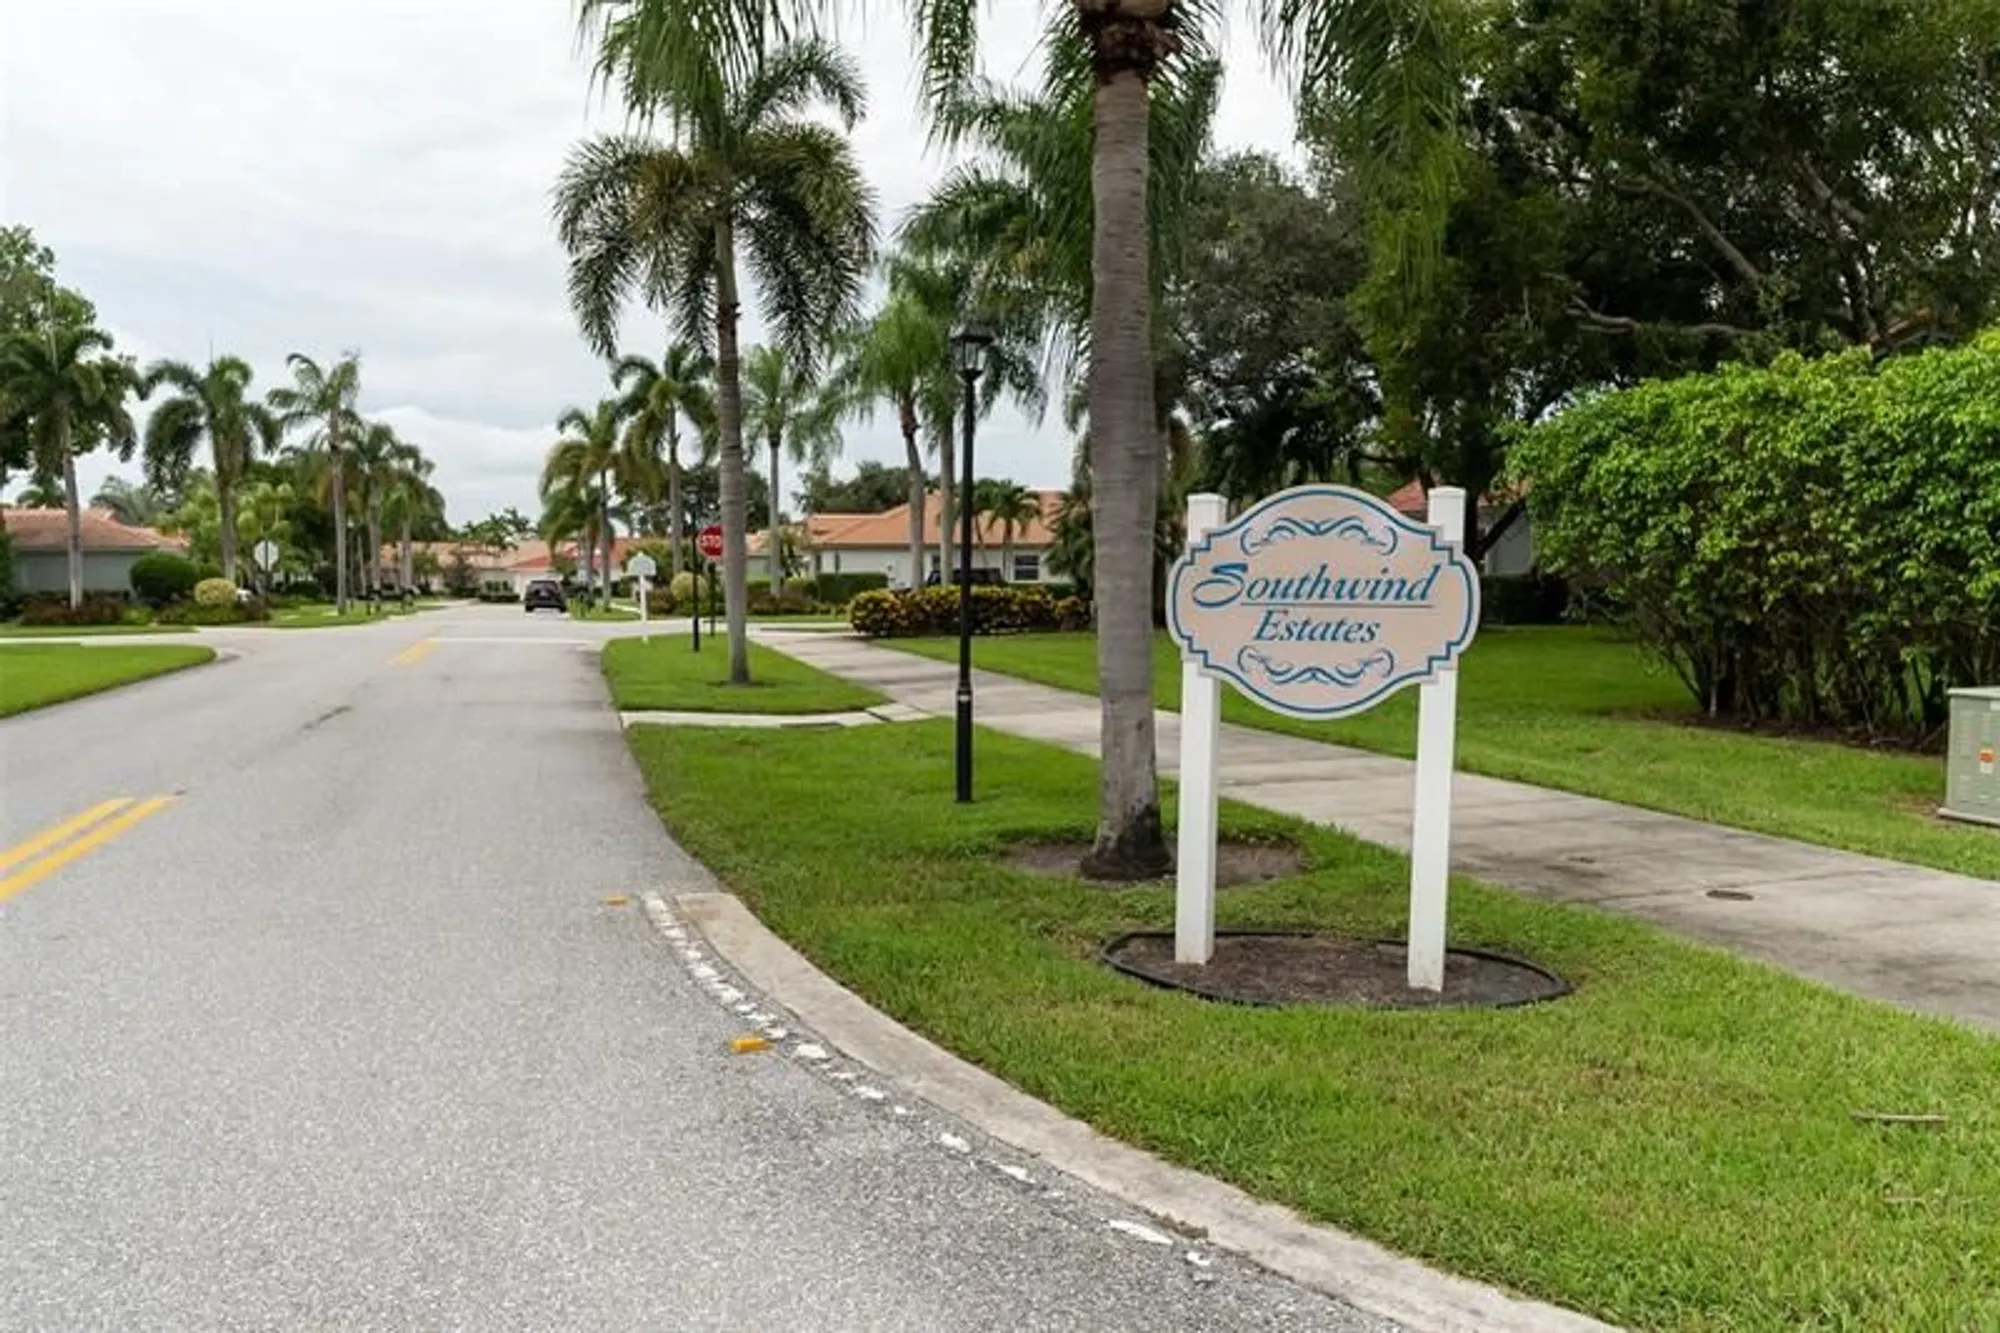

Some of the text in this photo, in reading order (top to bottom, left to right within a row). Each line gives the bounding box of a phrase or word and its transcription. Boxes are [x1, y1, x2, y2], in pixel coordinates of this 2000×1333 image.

[701, 535, 721, 548] STO
[1193, 562, 1441, 607] Southwind
[1254, 609, 1381, 642] Estates
